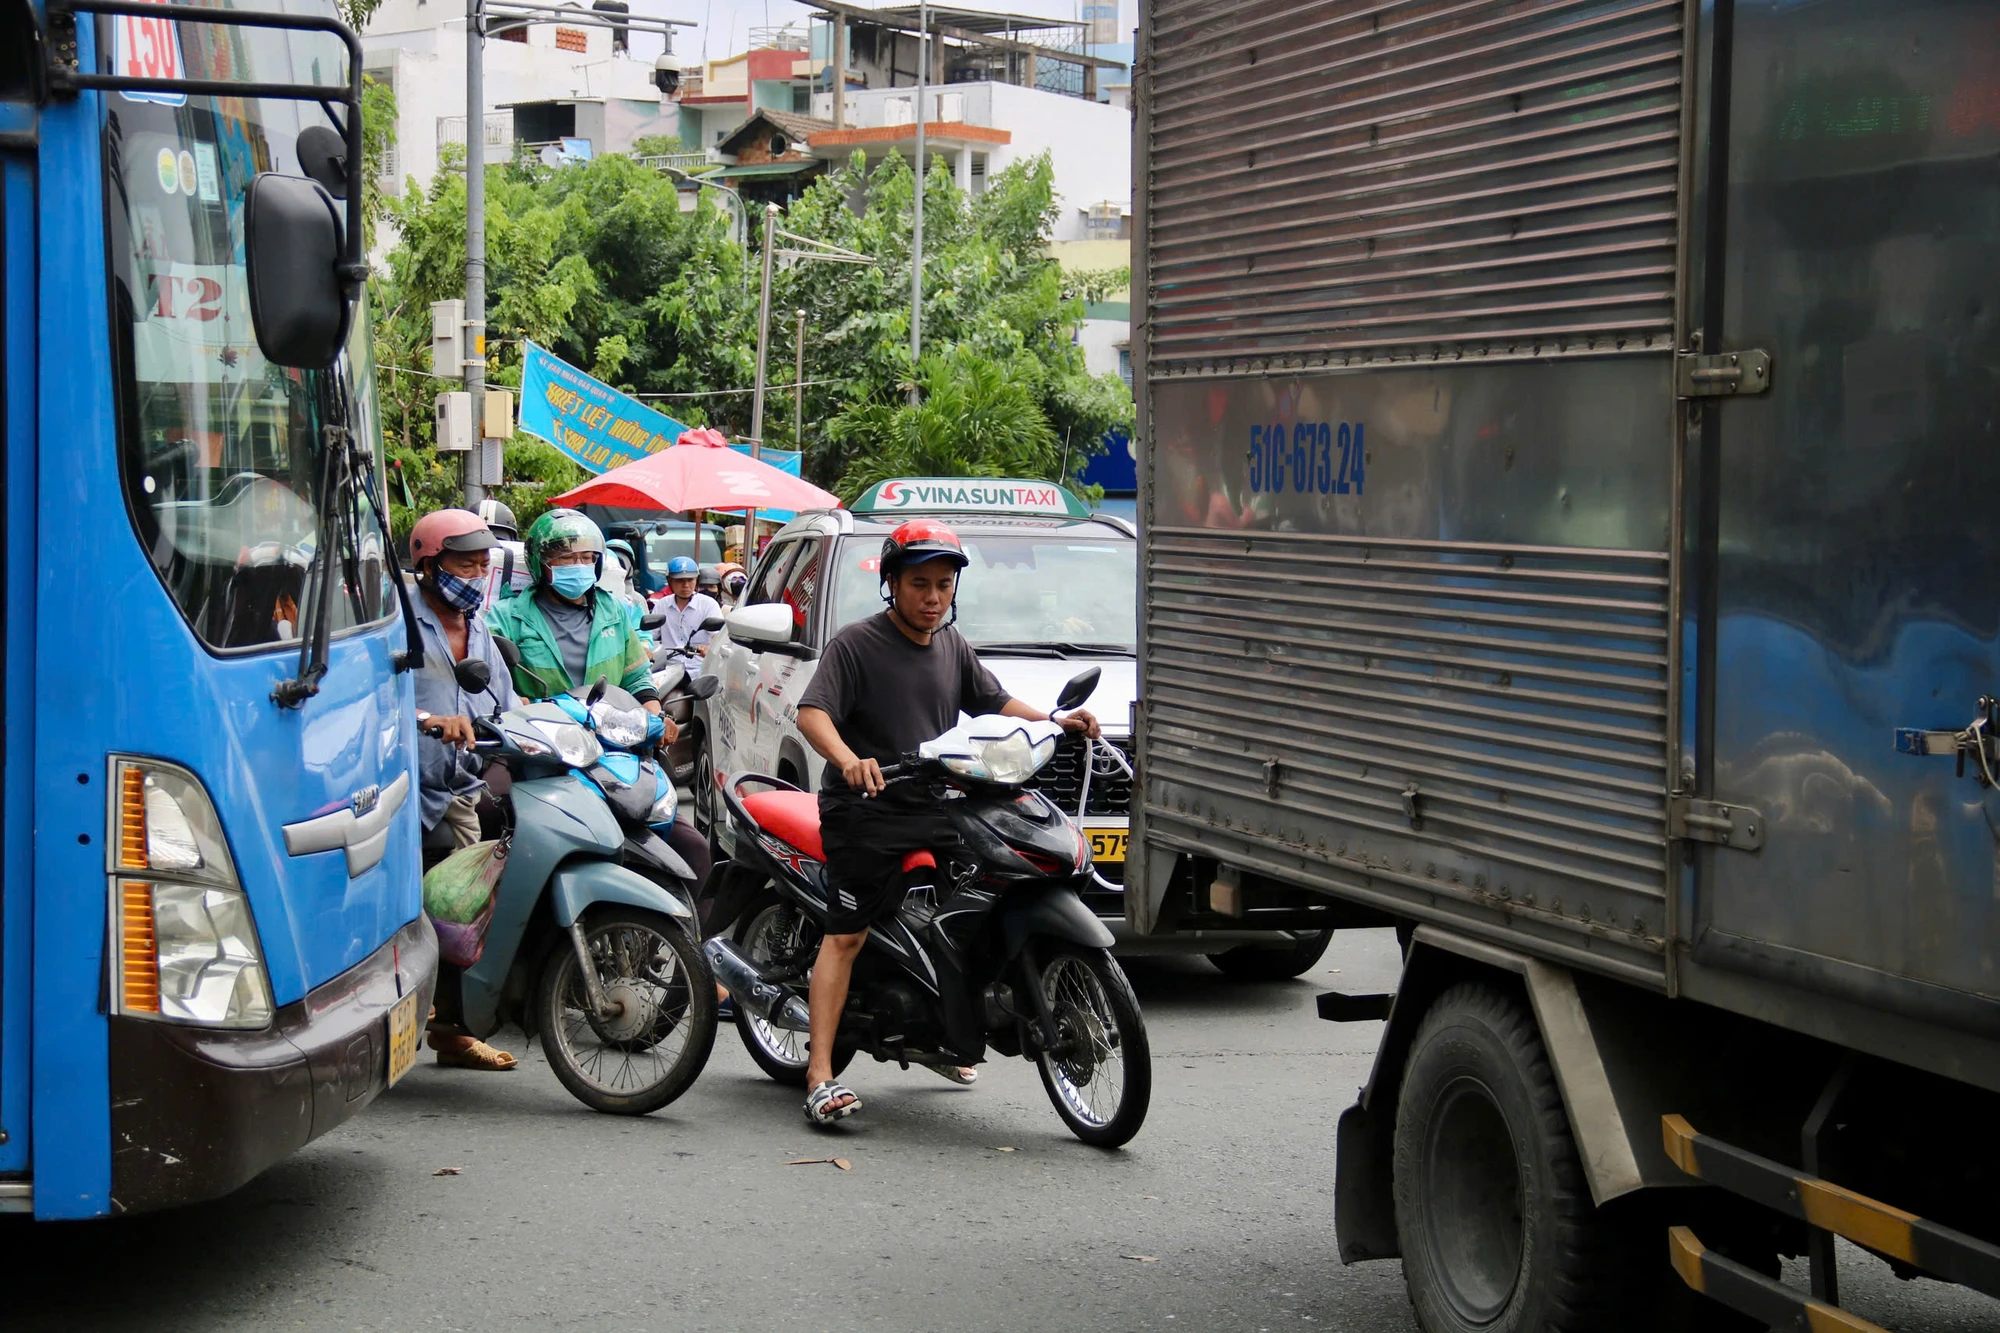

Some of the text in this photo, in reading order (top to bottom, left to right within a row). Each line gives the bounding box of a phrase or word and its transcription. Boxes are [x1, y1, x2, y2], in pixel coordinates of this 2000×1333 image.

[127, 0, 176, 79] 150
[148, 274, 222, 321] T2
[546, 382, 584, 416] NHIỆT
[580, 402, 614, 431] LIỆT
[608, 417, 650, 450] HƯỞNG
[583, 441, 610, 466] LAO
[1250, 422, 1364, 495] 51C-673.24
